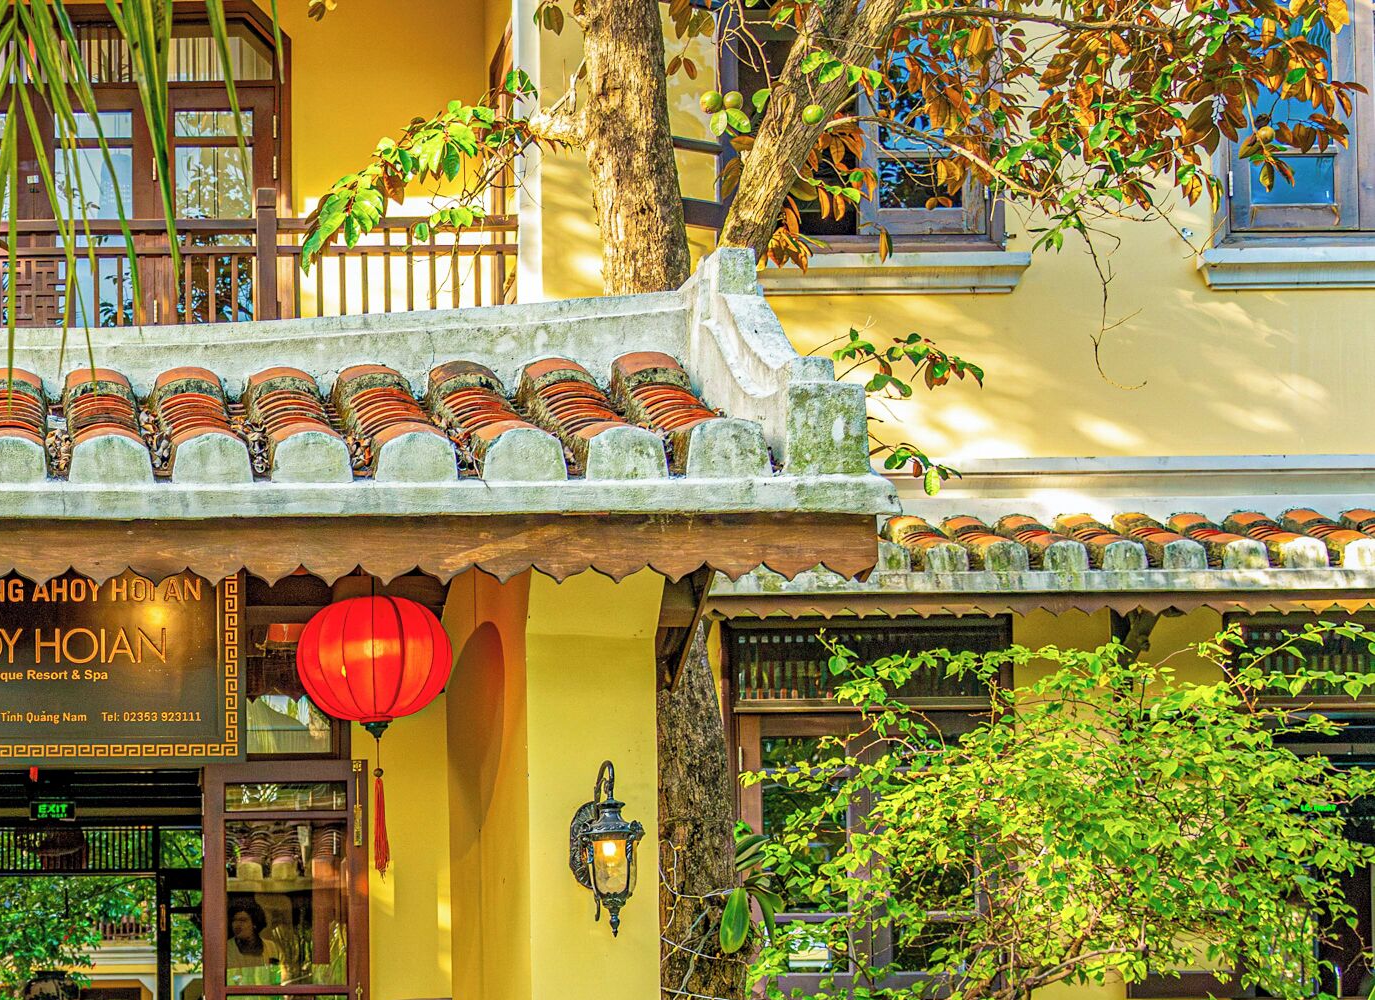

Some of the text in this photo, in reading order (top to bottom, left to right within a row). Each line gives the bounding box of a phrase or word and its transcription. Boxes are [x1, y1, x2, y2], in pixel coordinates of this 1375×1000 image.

[32, 579, 100, 602] AHOY
[164, 578, 201, 602] AN
[35, 627, 167, 664] HOIAN
[27, 669, 68, 680] Resort
[72, 670, 80, 680] &
[84, 669, 108, 682] Spa
[1, 711, 23, 721] Tỉnh
[26, 711, 59, 724] Quảng
[62, 712, 87, 721] Nam
[101, 712, 120, 721] Tel:
[123, 712, 158, 722] 02353
[161, 712, 201, 722] 923111
[38, 804, 68, 813] EXIT
